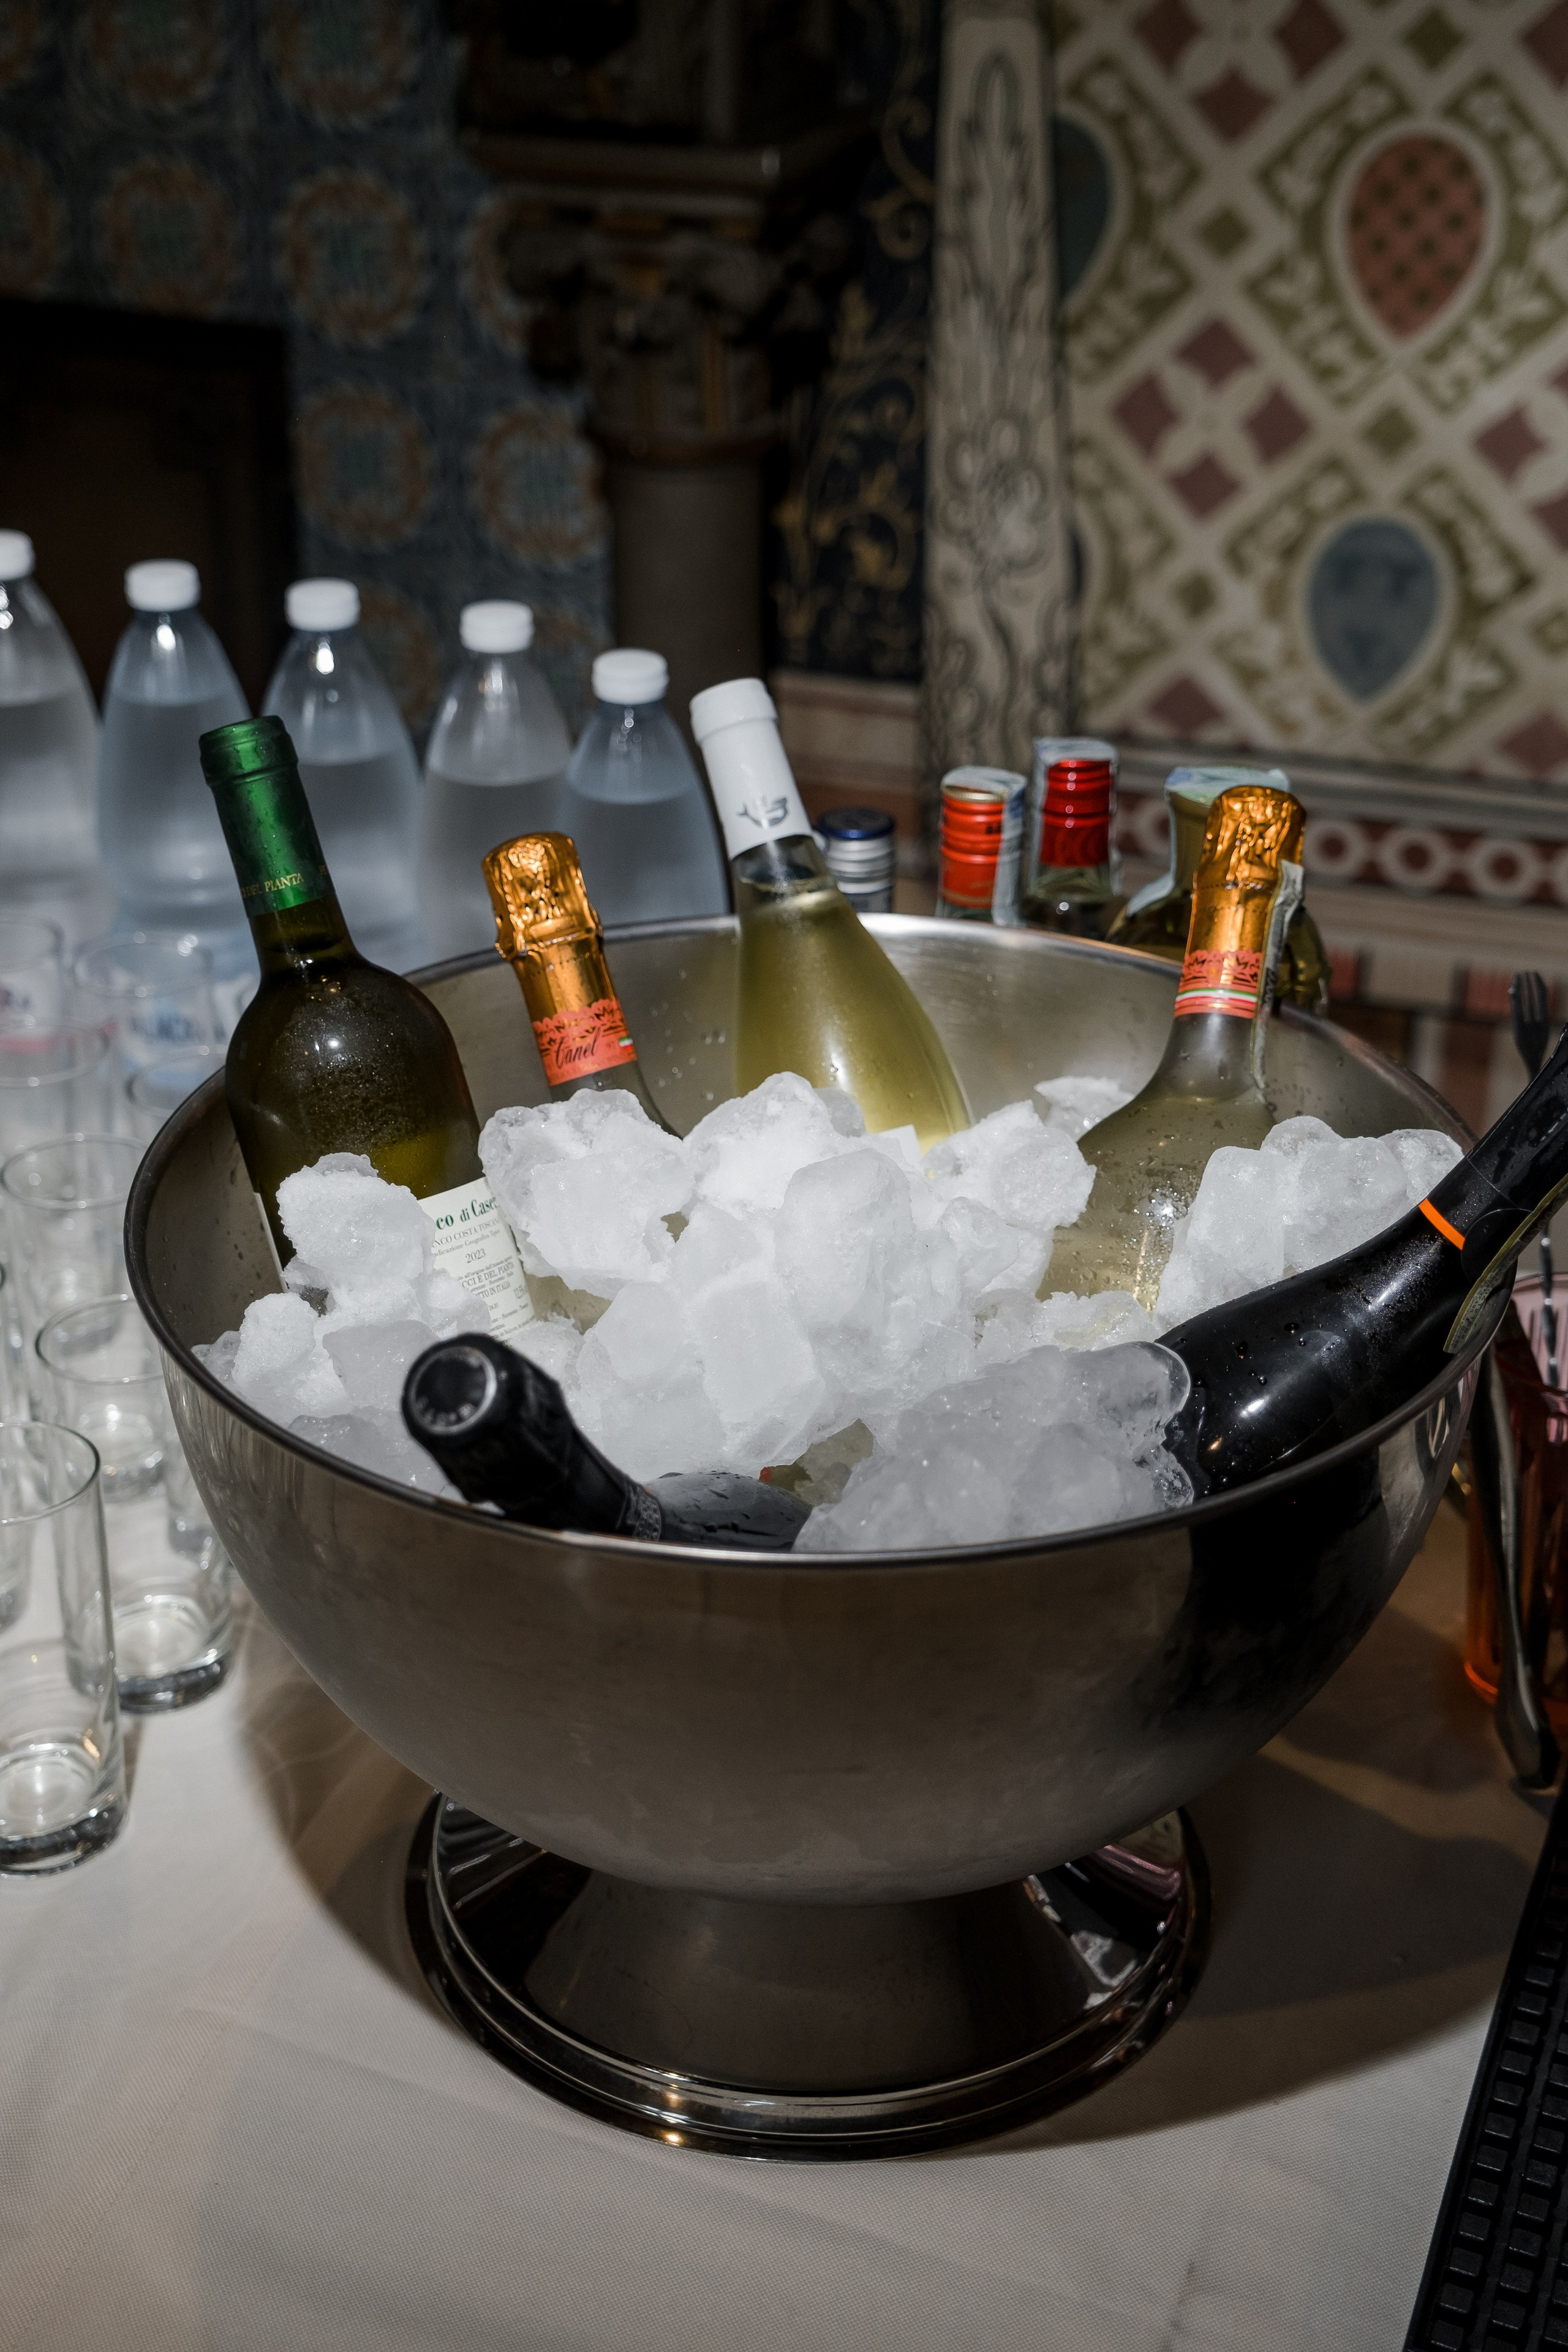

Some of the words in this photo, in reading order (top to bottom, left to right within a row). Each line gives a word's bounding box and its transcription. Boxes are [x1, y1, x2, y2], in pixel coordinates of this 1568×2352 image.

[265, 873, 304, 892] PIANTA
[436, 1215, 454, 1230] co
[460, 1208, 470, 1223] di
[432, 1235, 452, 1248] NCO
[454, 1226, 478, 1241] COSTA
[466, 1248, 486, 1264] 2023
[461, 1278, 477, 1289] CCI
[484, 1270, 498, 1281] DEL
[476, 1290, 489, 1298] TTO
